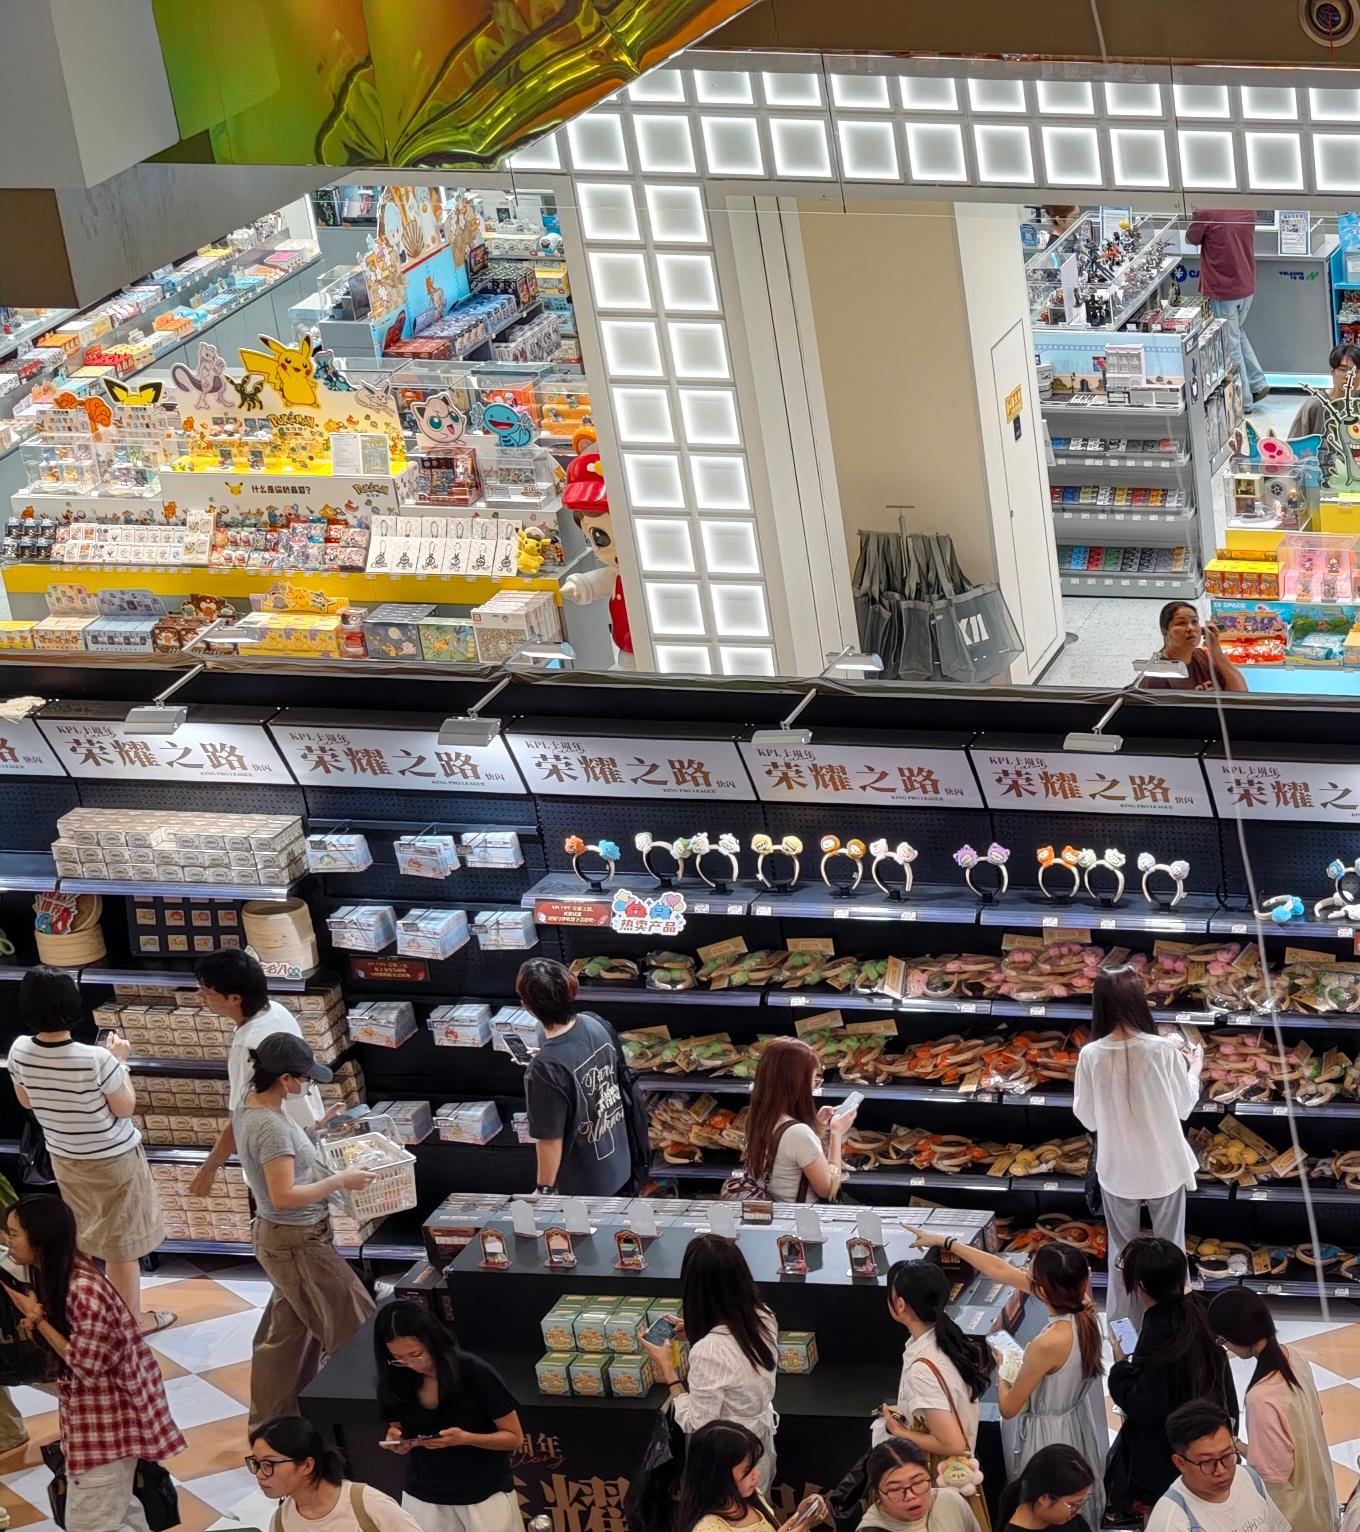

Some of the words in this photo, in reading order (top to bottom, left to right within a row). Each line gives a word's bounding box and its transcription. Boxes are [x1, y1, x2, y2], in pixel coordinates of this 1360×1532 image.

[65, 737, 249, 772] 荣耀之路
[296, 743, 482, 781] 荣耀之路
[532, 753, 713, 788] 荣耀之路
[762, 761, 942, 795] 荣耀之路
[993, 769, 1172, 803] 荣耀之路
[620, 918, 677, 933] 热卖产品
